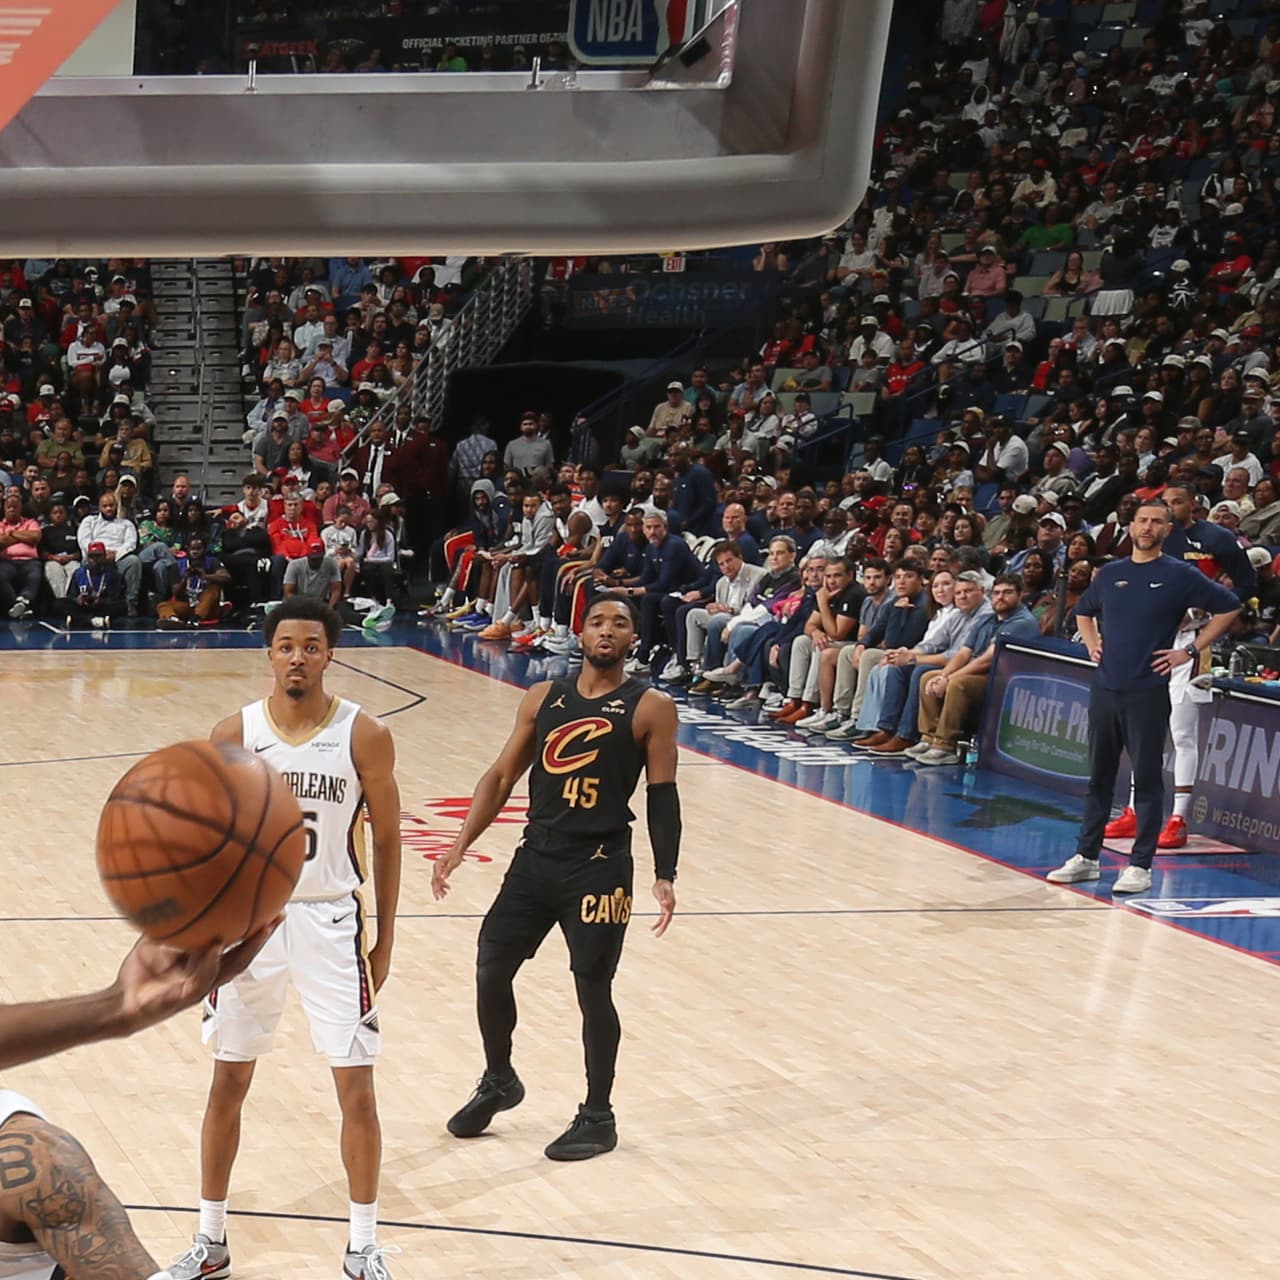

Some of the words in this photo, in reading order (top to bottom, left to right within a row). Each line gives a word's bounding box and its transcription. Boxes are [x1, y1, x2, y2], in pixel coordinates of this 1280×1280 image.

[587, 0, 643, 43] NBA
[402, 38, 444, 49] OFFICIAL
[495, 33, 539, 45] PARTNER
[1008, 687, 1065, 737] WASTE
[562, 777, 600, 809] 45
[580, 886, 633, 924] CAVS
